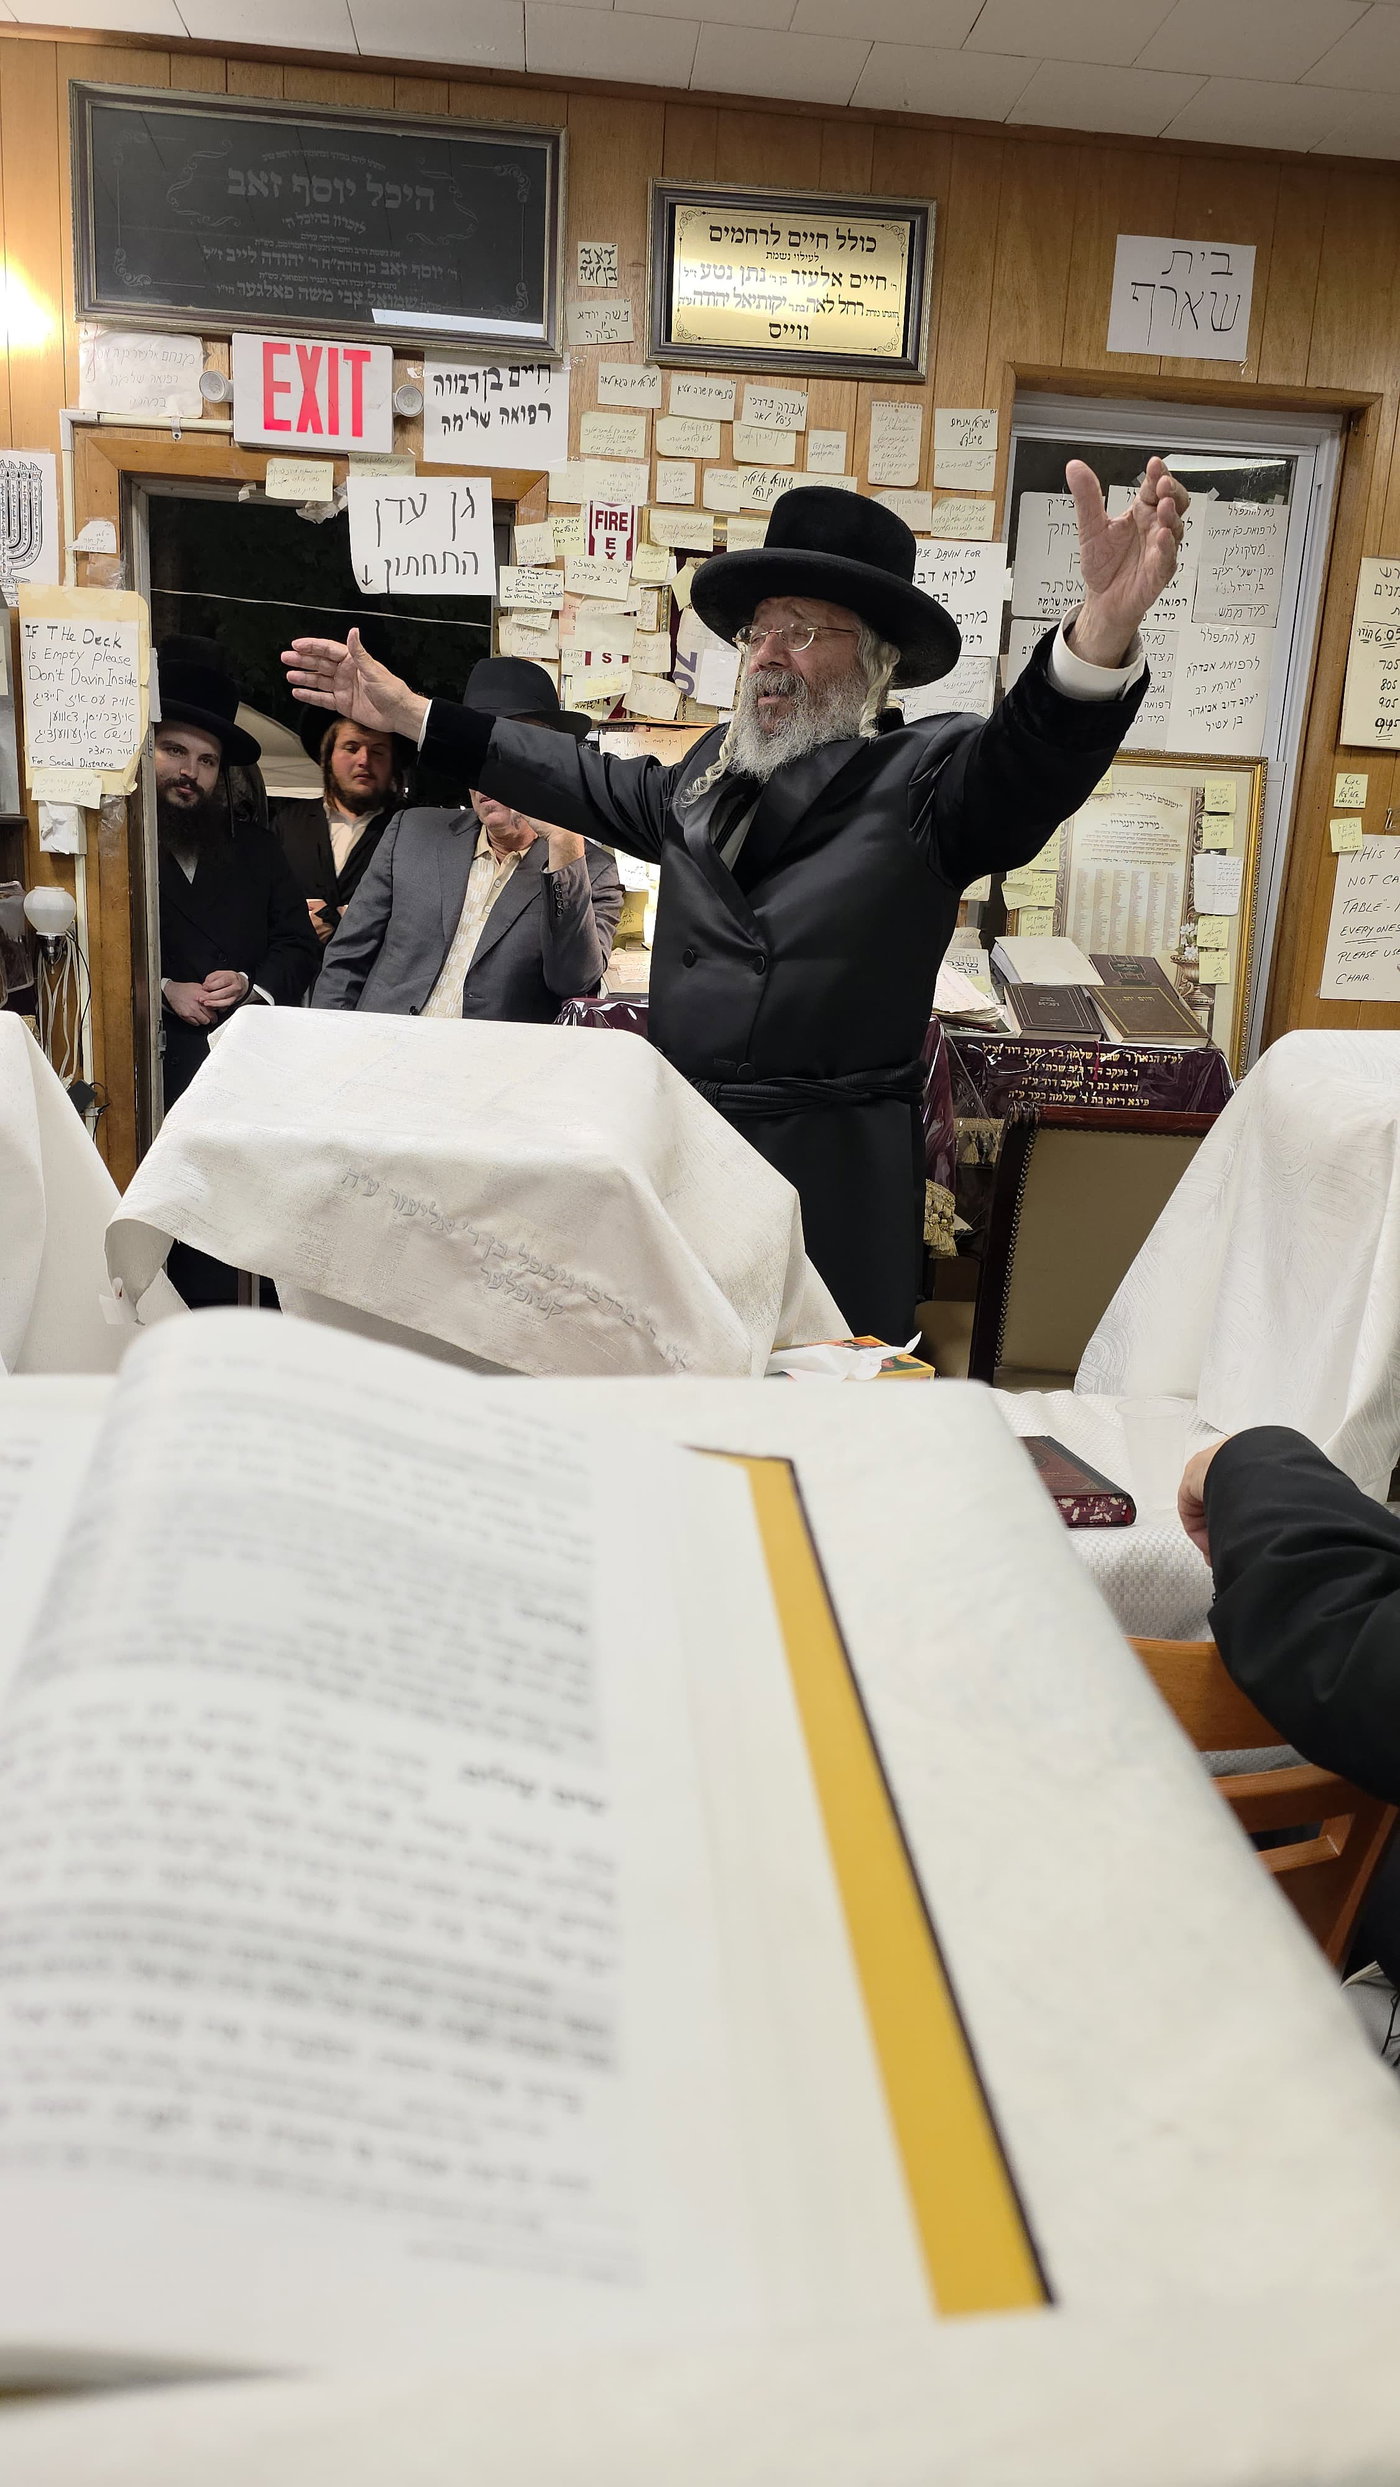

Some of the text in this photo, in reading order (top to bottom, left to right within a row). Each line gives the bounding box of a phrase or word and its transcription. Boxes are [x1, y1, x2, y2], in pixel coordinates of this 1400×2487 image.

[227, 167, 435, 212] היכל יוסף זאב
[709, 222, 878, 253] כולל חיים לרחמים
[225, 246, 258, 264] לייב
[260, 250, 304, 268] יהודה
[765, 251, 820, 263] לעילוי נשמת
[1161, 247, 1234, 278] בית
[364, 260, 377, 276] בן
[380, 260, 408, 277] זאב
[411, 263, 444, 280] יוסף
[603, 266, 617, 286] בן
[700, 263, 733, 281] נטע
[740, 265, 766, 287] נתן
[790, 265, 843, 288] אלעזר
[779, 275, 788, 285] בן
[849, 272, 888, 291] חיים
[298, 285, 334, 304] משה
[338, 290, 362, 311] צבי
[694, 287, 865, 316] רחל לאה יקותיאל יהודה
[1130, 280, 1241, 346] שארף
[768, 322, 810, 341] ווייס
[161, 349, 195, 366] מנחם
[150, 373, 179, 385] רפואה
[480, 366, 504, 402] בן
[507, 362, 552, 394] חיים
[262, 341, 371, 438] EXIT
[440, 401, 552, 437] רפואה שלימה
[375, 487, 475, 548] גן עדן
[595, 509, 629, 532] FIRE
[1264, 507, 1275, 517] נא
[1243, 524, 1278, 536] לרפואת
[964, 549, 981, 558] FOR
[384, 551, 479, 594] התחתון
[1212, 566, 1274, 581] מרן יעקב
[1254, 583, 1265, 594] בן
[1158, 597, 1188, 607] רפואה
[956, 610, 988, 626] מרים
[1247, 605, 1266, 617] מיד
[24, 624, 39, 640] IF
[83, 627, 122, 649] Deck
[1200, 629, 1256, 646] נא להתפלל
[28, 645, 131, 670] Is Empty please
[1219, 656, 1261, 672] לרפואת
[28, 665, 138, 688] Don't Davin Inside
[1195, 685, 1207, 696] רב
[1144, 701, 1171, 709] רפואה
[1221, 698, 1237, 710] דוב
[1238, 693, 1259, 708] יעקב
[1232, 715, 1243, 728] בן
[49, 755, 74, 767] Social
[1348, 874, 1379, 888] NOT
[1337, 949, 1379, 964] PLEASE
[1004, 1045, 1022, 1055] דוד
[1024, 1047, 1047, 1060] יעקב
[1041, 1078, 1058, 1088] דוד
[1098, 1081, 1110, 1091] בת
[1049, 1091, 1077, 1103] שלמה
[484, 1236, 507, 1260] בן
